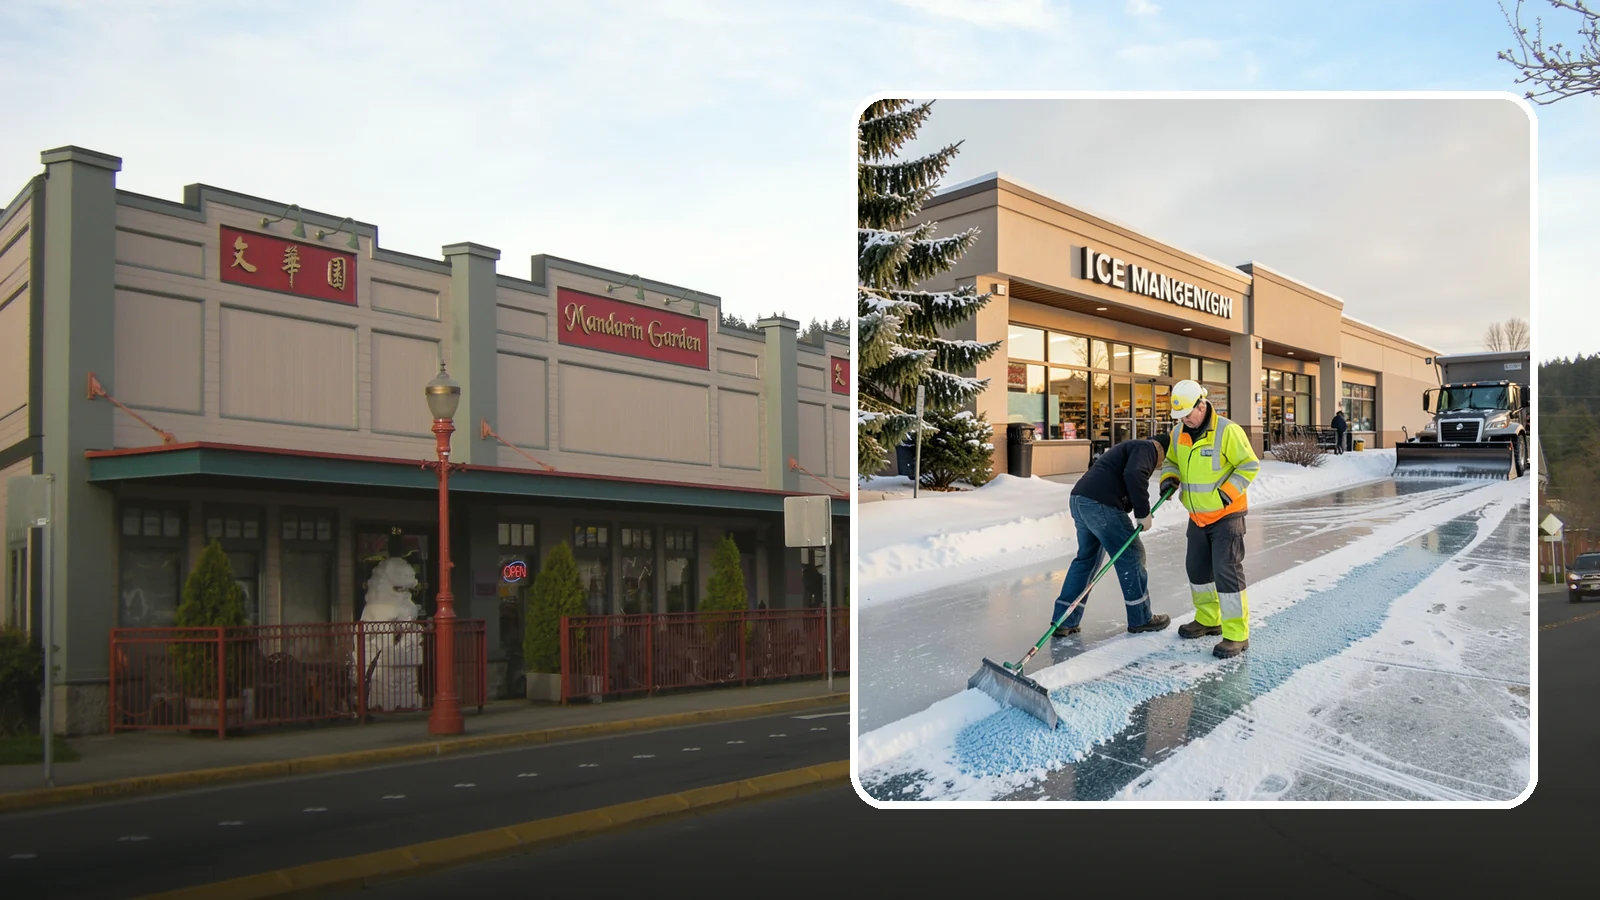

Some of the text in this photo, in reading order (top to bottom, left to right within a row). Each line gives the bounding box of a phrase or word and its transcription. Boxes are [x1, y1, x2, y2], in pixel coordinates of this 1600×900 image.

[230, 235, 346, 291] 文華園
[1082, 246, 1125, 289] ICE
[564, 302, 701, 352] Mandarin Garden
[503, 565, 526, 578] OPEN
